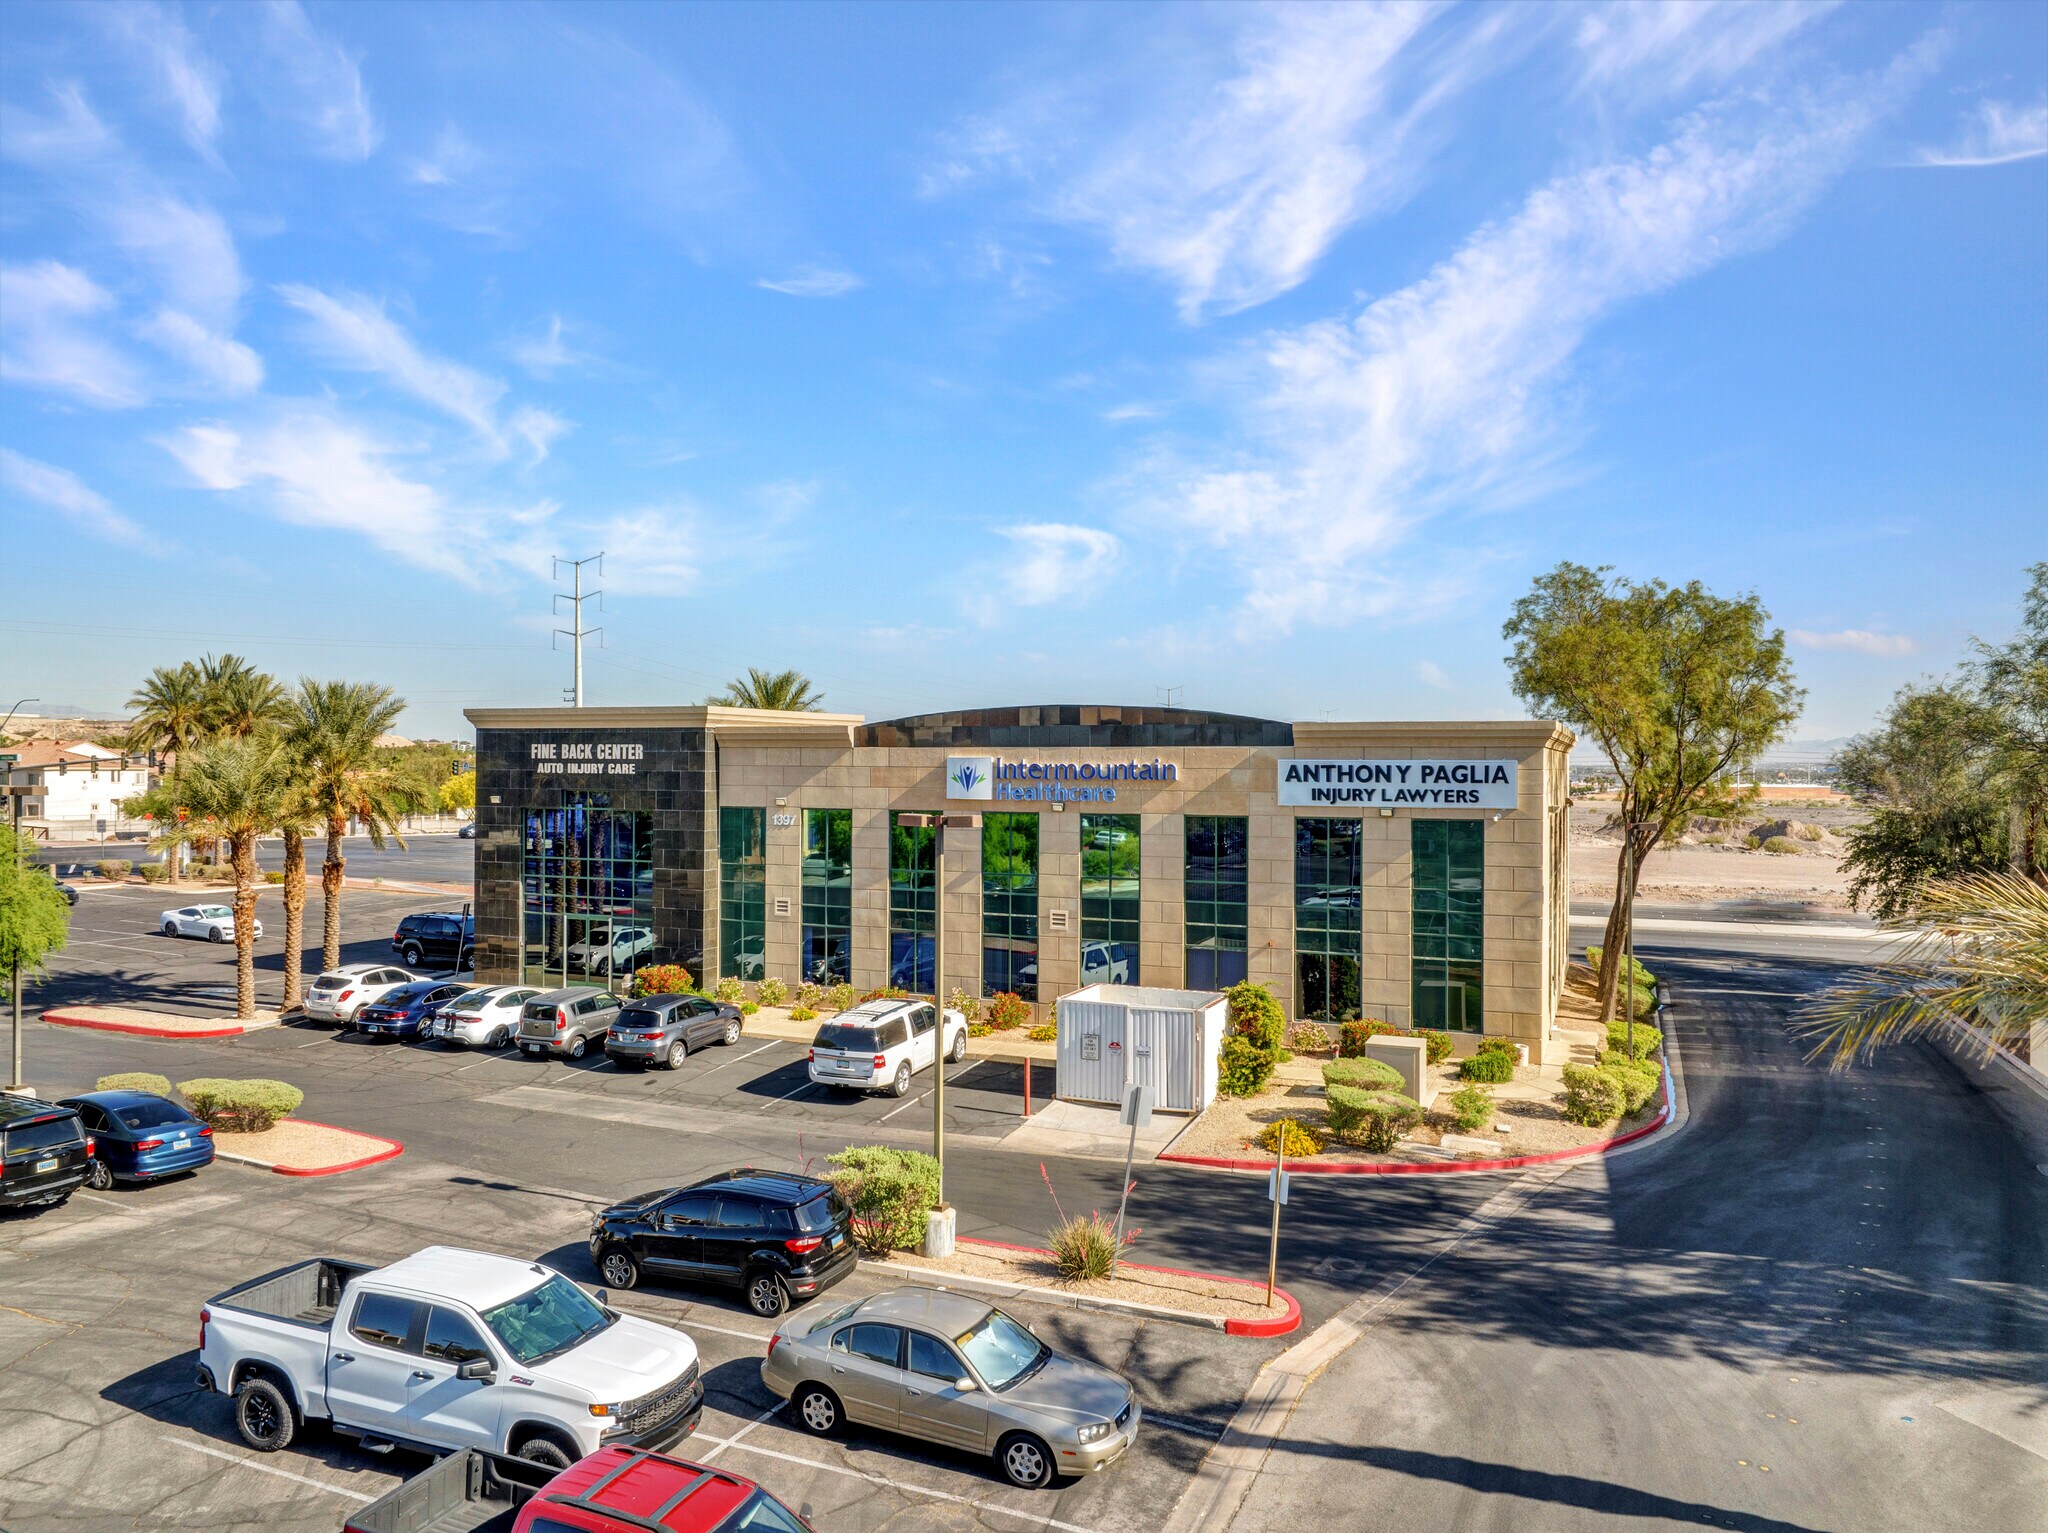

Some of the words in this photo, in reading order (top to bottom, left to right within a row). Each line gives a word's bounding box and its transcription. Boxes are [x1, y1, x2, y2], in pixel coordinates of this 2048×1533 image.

[531, 743, 557, 759] FINE
[561, 744, 593, 760] BACK
[597, 744, 644, 760] CENTER
[537, 762, 564, 774] AUTO
[567, 763, 604, 774] INJURY
[608, 763, 636, 775] CARE
[996, 757, 1178, 781] Intermountain
[1285, 764, 1412, 784] ANTHONY
[1421, 765, 1510, 785] PAGLIA
[996, 781, 1117, 803] Healthcare
[1311, 787, 1376, 805] INJURY
[1381, 788, 1480, 804] LAWYERS
[771, 814, 797, 826] 1397
